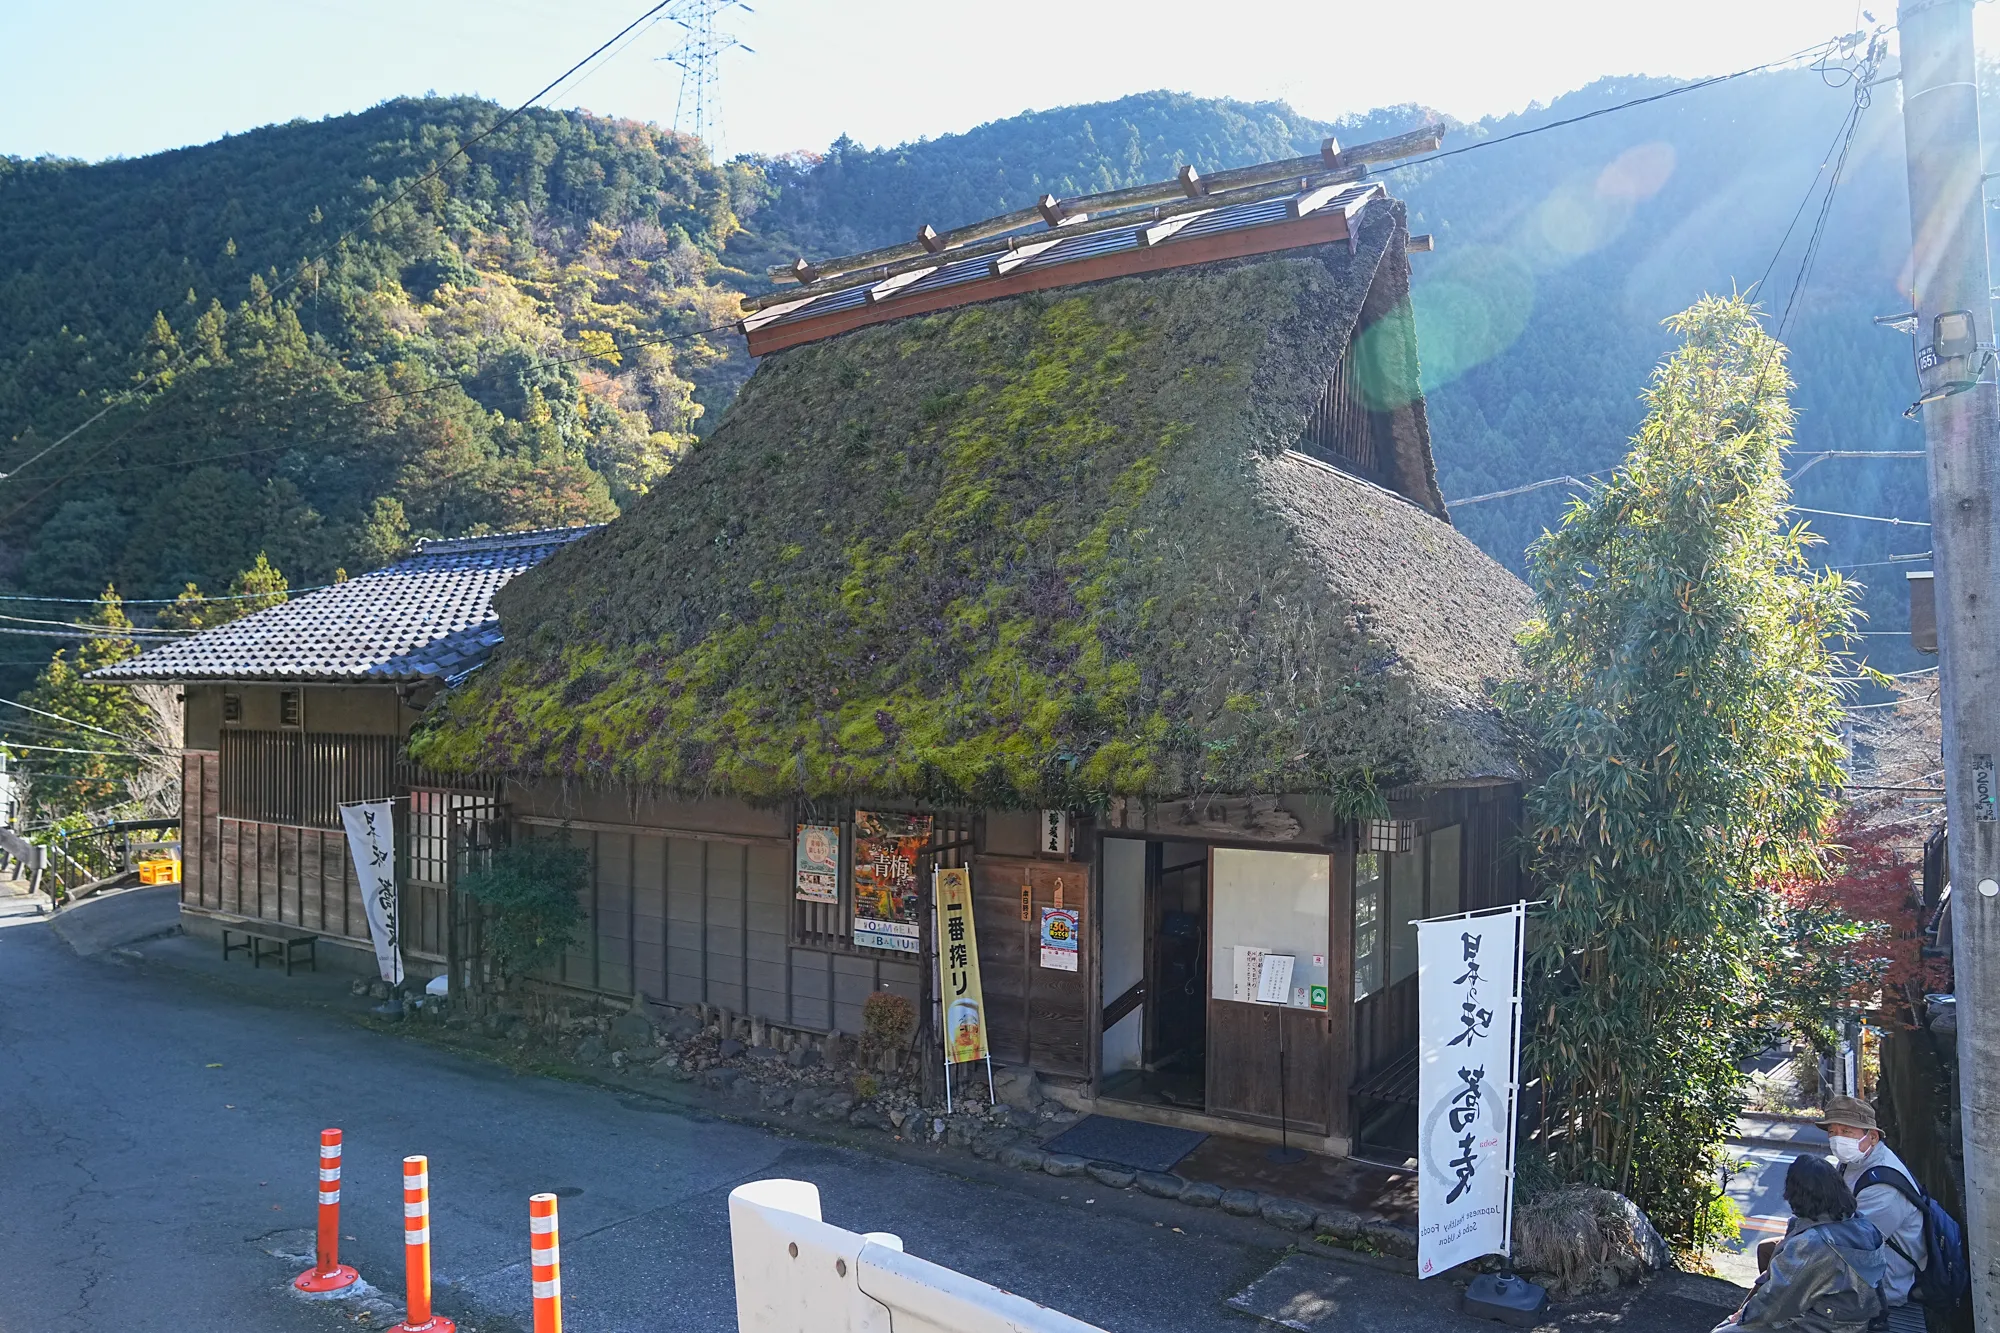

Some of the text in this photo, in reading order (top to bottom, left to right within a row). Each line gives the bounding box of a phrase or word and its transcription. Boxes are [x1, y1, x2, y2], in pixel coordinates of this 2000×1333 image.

[871, 844, 895, 853] ちょっと
[873, 854, 910, 879] 青梅
[947, 903, 967, 995] 一番搾り
